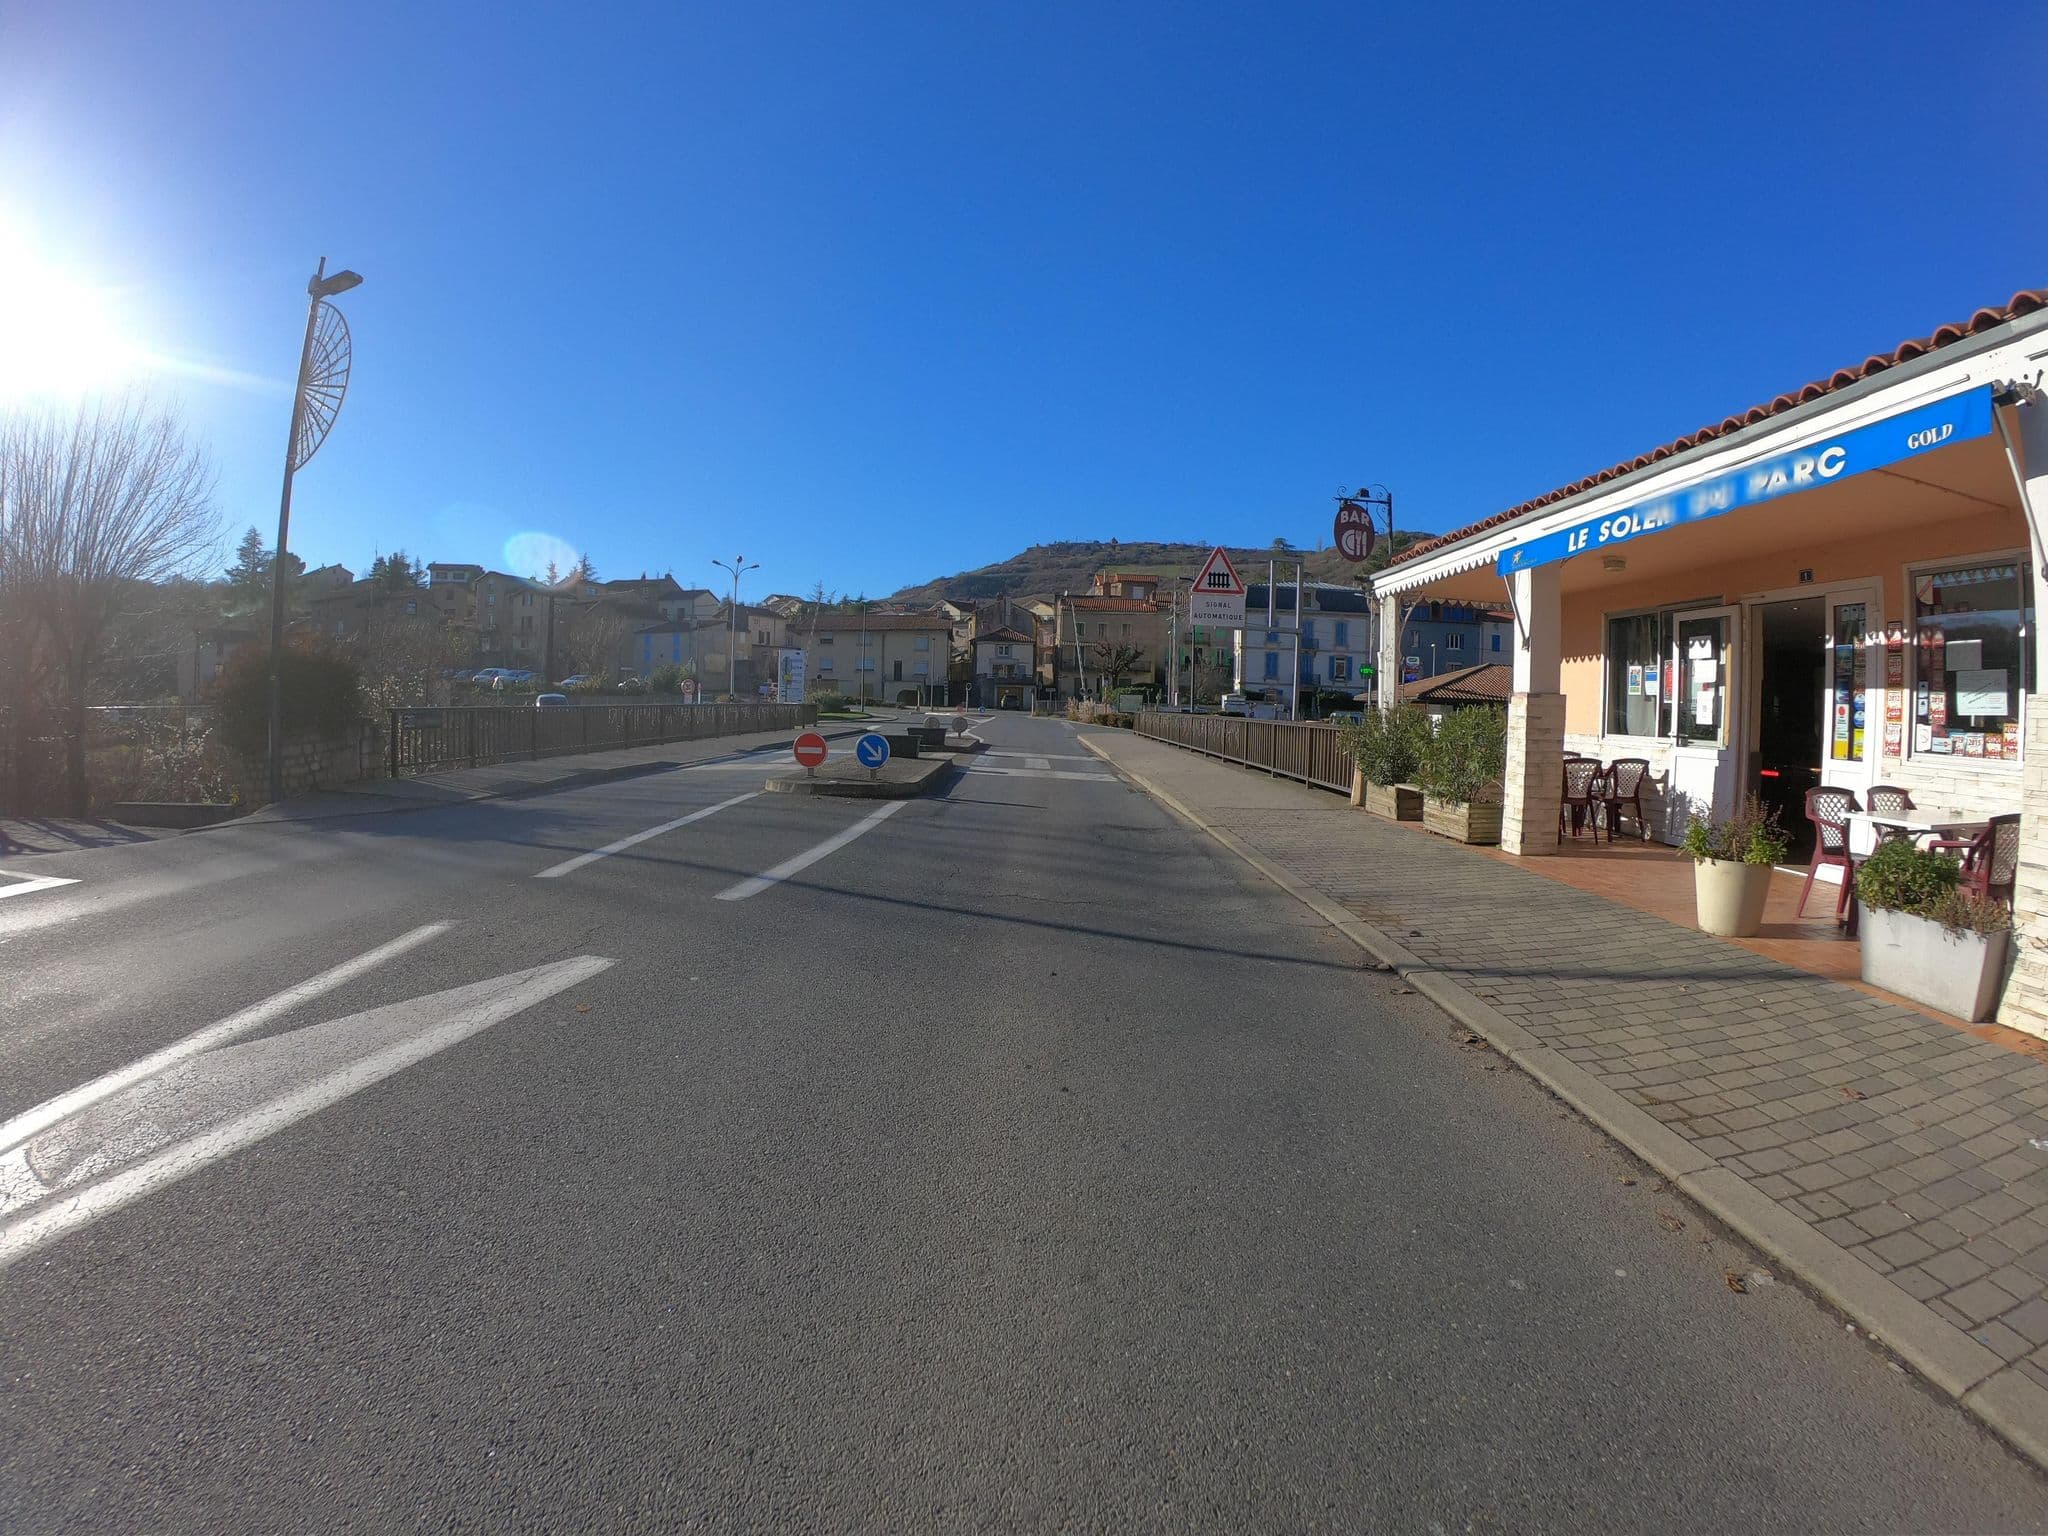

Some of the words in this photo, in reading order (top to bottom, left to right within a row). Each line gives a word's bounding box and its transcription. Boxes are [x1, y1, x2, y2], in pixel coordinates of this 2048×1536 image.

[1907, 423, 1954, 451] GOLD
[1568, 527, 1589, 553] LE
[1598, 503, 1674, 543] SOLEI
[1747, 445, 1846, 495] PARC
[1340, 510, 1370, 527] BAR
[1205, 601, 1232, 609] SIGNAL
[1193, 612, 1244, 621] AUTOMATIQUE
